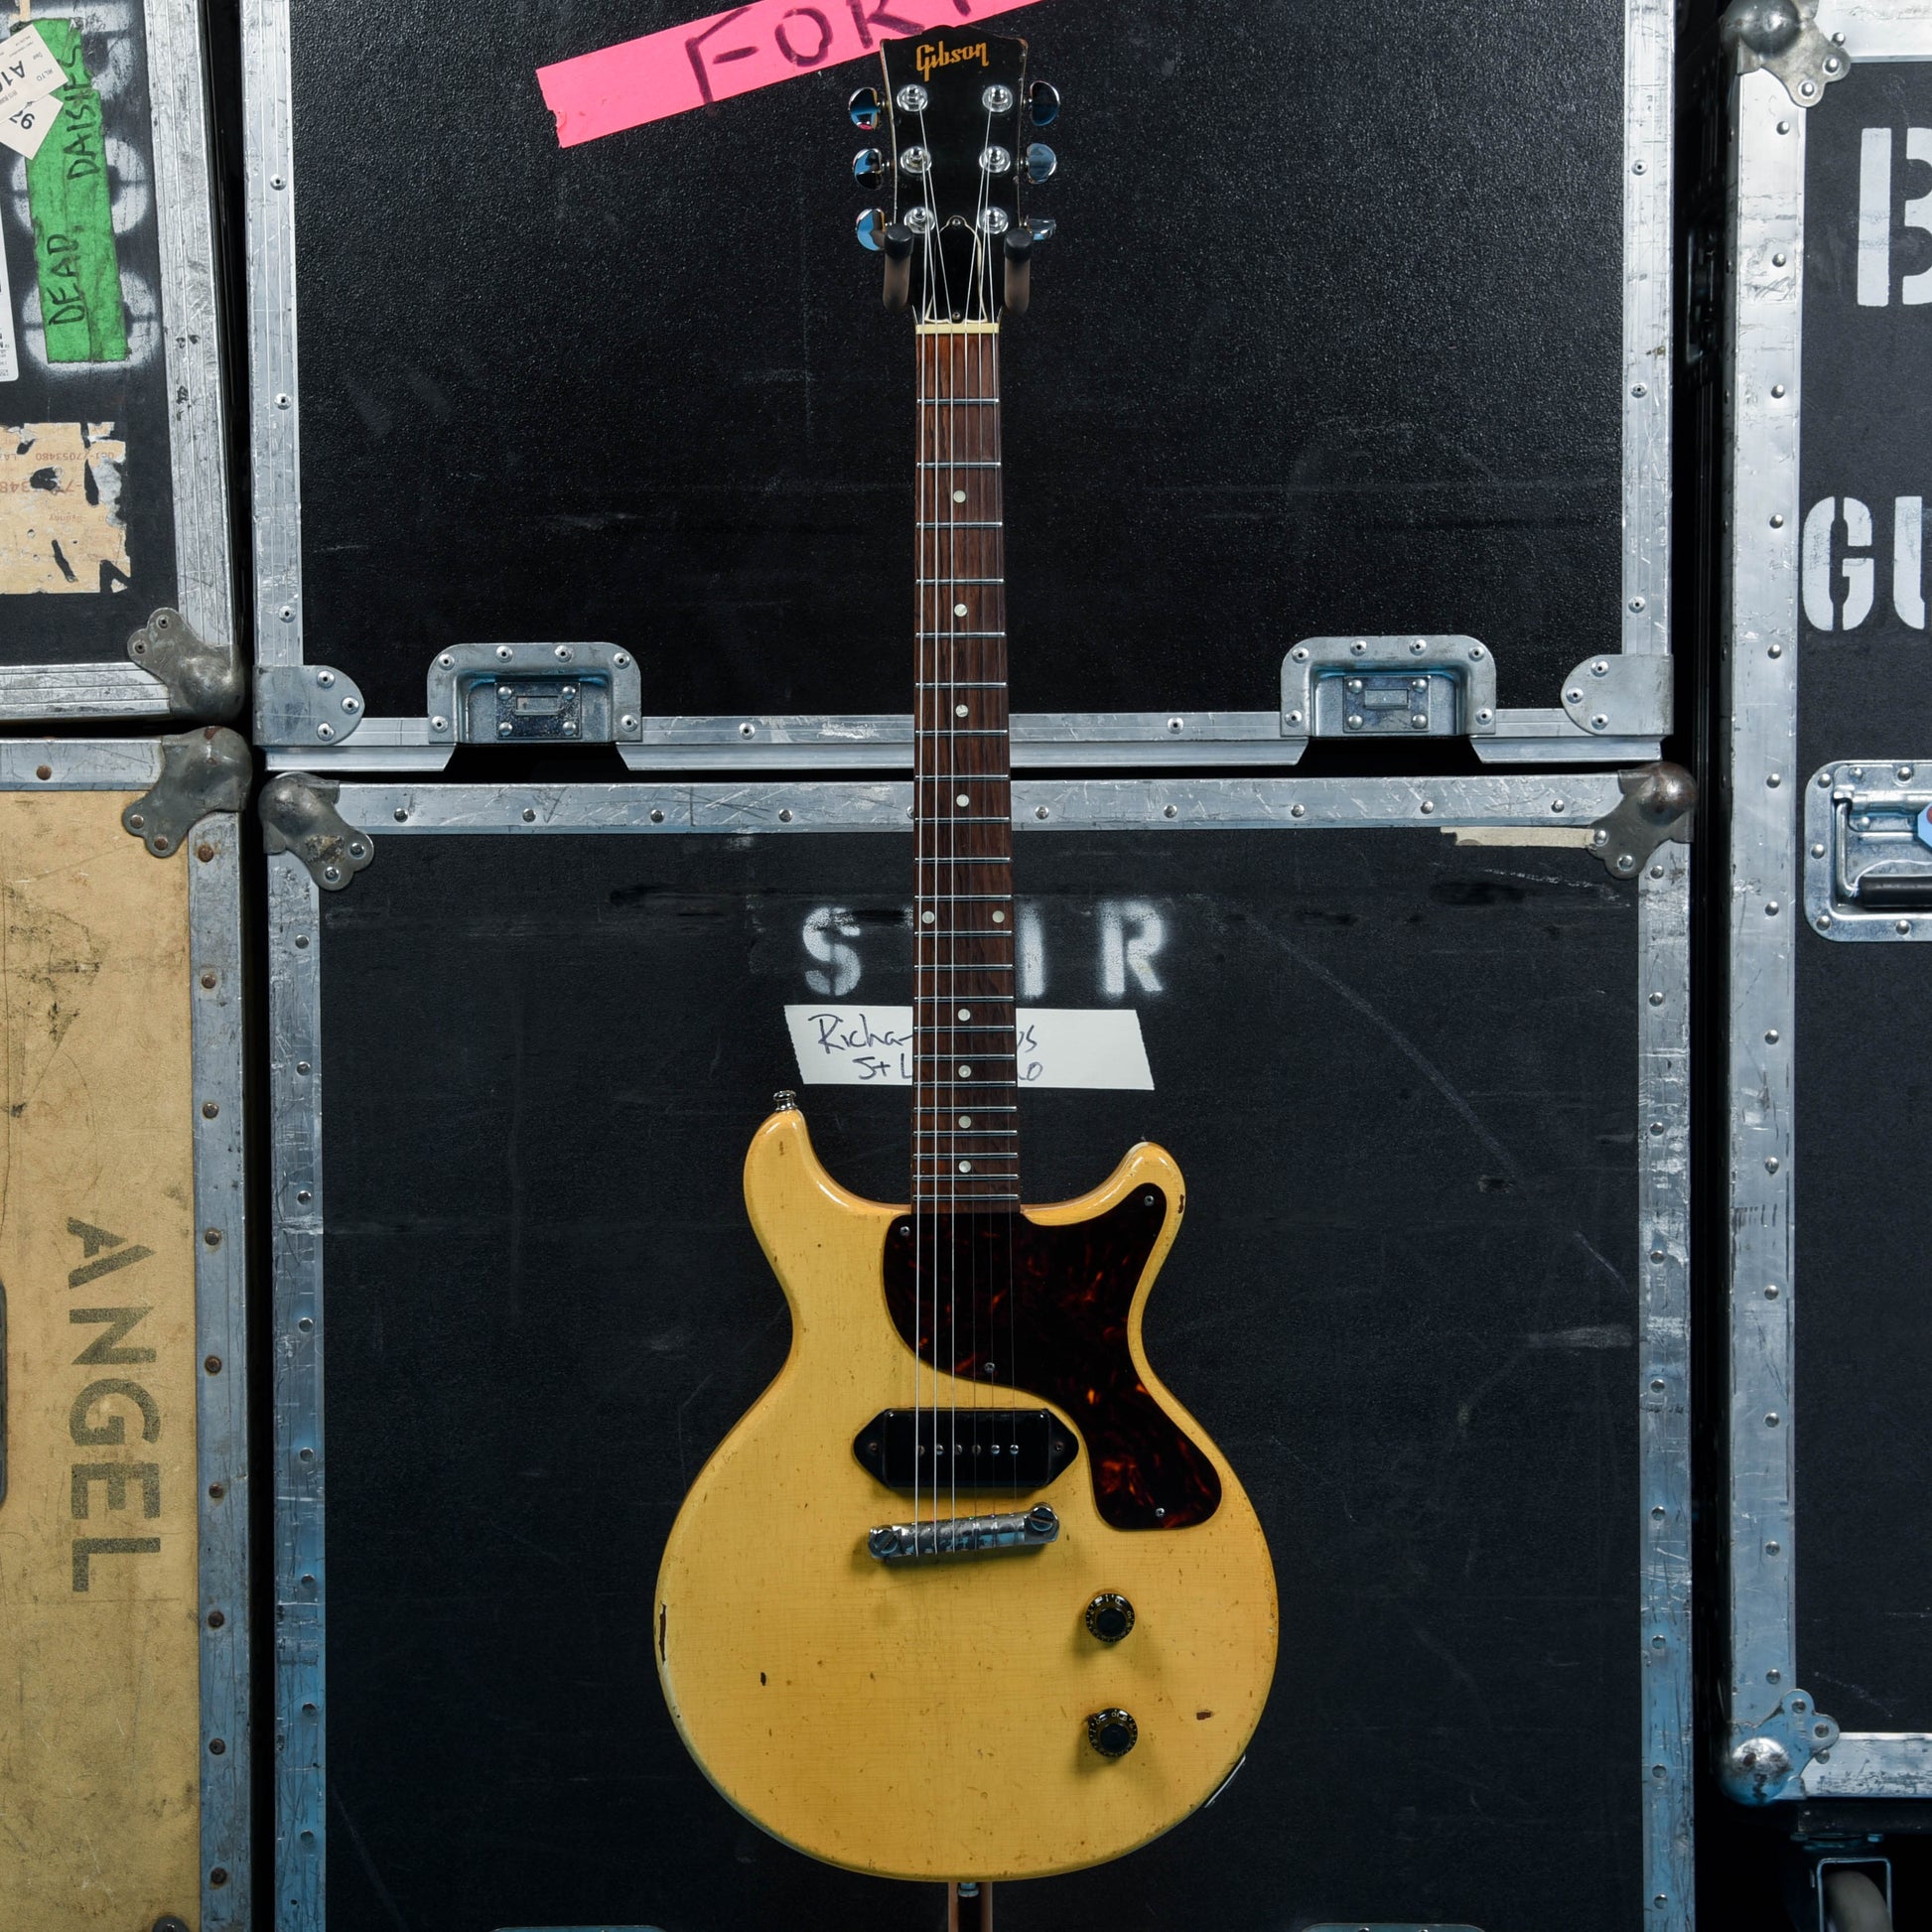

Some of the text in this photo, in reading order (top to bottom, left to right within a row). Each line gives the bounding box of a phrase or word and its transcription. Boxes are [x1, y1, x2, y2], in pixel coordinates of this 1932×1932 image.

[685, 0, 971, 104] FOR
[916, 41, 989, 82] Gibson
[47, 45, 99, 327] DEAD DAISIES
[808, 1013, 913, 1054] Richa
[67, 1216, 162, 1592] ANGEL
